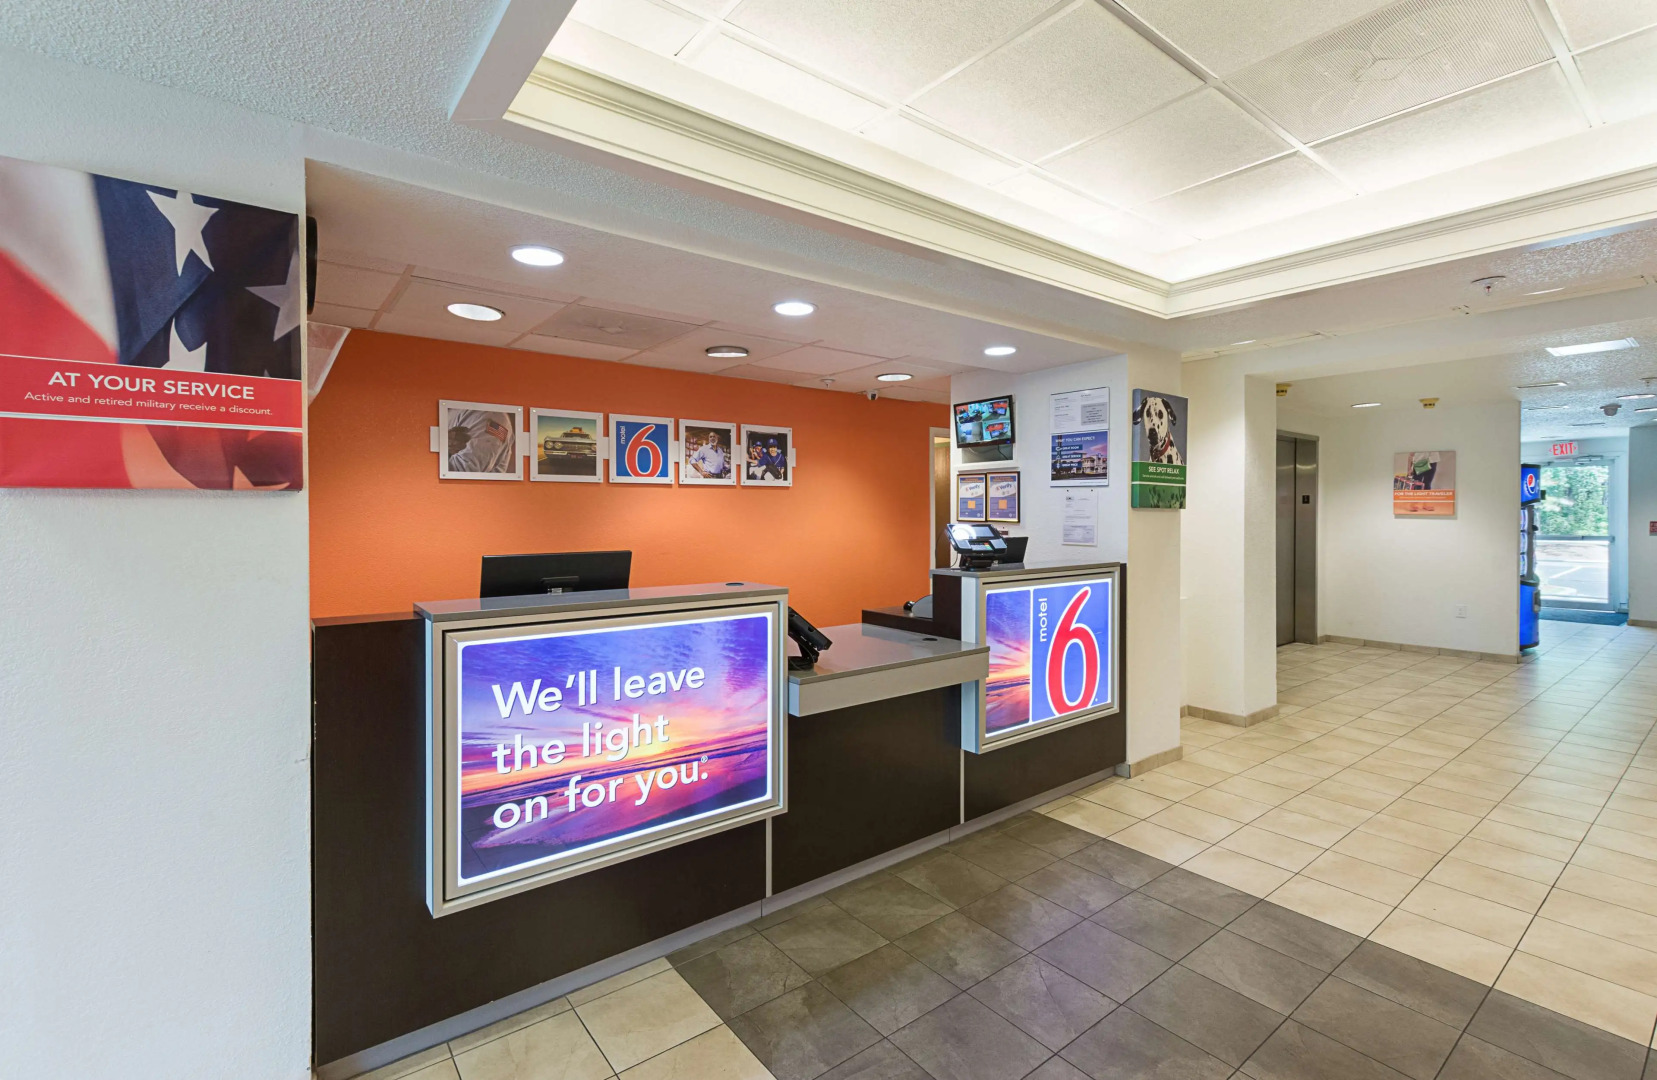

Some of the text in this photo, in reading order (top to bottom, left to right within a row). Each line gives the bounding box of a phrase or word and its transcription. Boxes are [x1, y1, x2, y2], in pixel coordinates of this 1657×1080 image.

[24, 391, 64, 403] Active
[67, 394, 91, 404] and
[94, 396, 133, 407] retired
[136, 398, 176, 411] military
[179, 402, 217, 412] receive
[228, 404, 273, 416] discount.
[48, 371, 255, 399] AT YOUR SERVICE
[625, 424, 663, 478] 6
[1552, 442, 1574, 456] EXIT
[1038, 597, 1048, 642] motel
[1045, 586, 1101, 716] 6
[492, 666, 705, 719] We'll leave
[492, 713, 670, 775] the light
[492, 793, 549, 830] on
[564, 775, 624, 813] for
